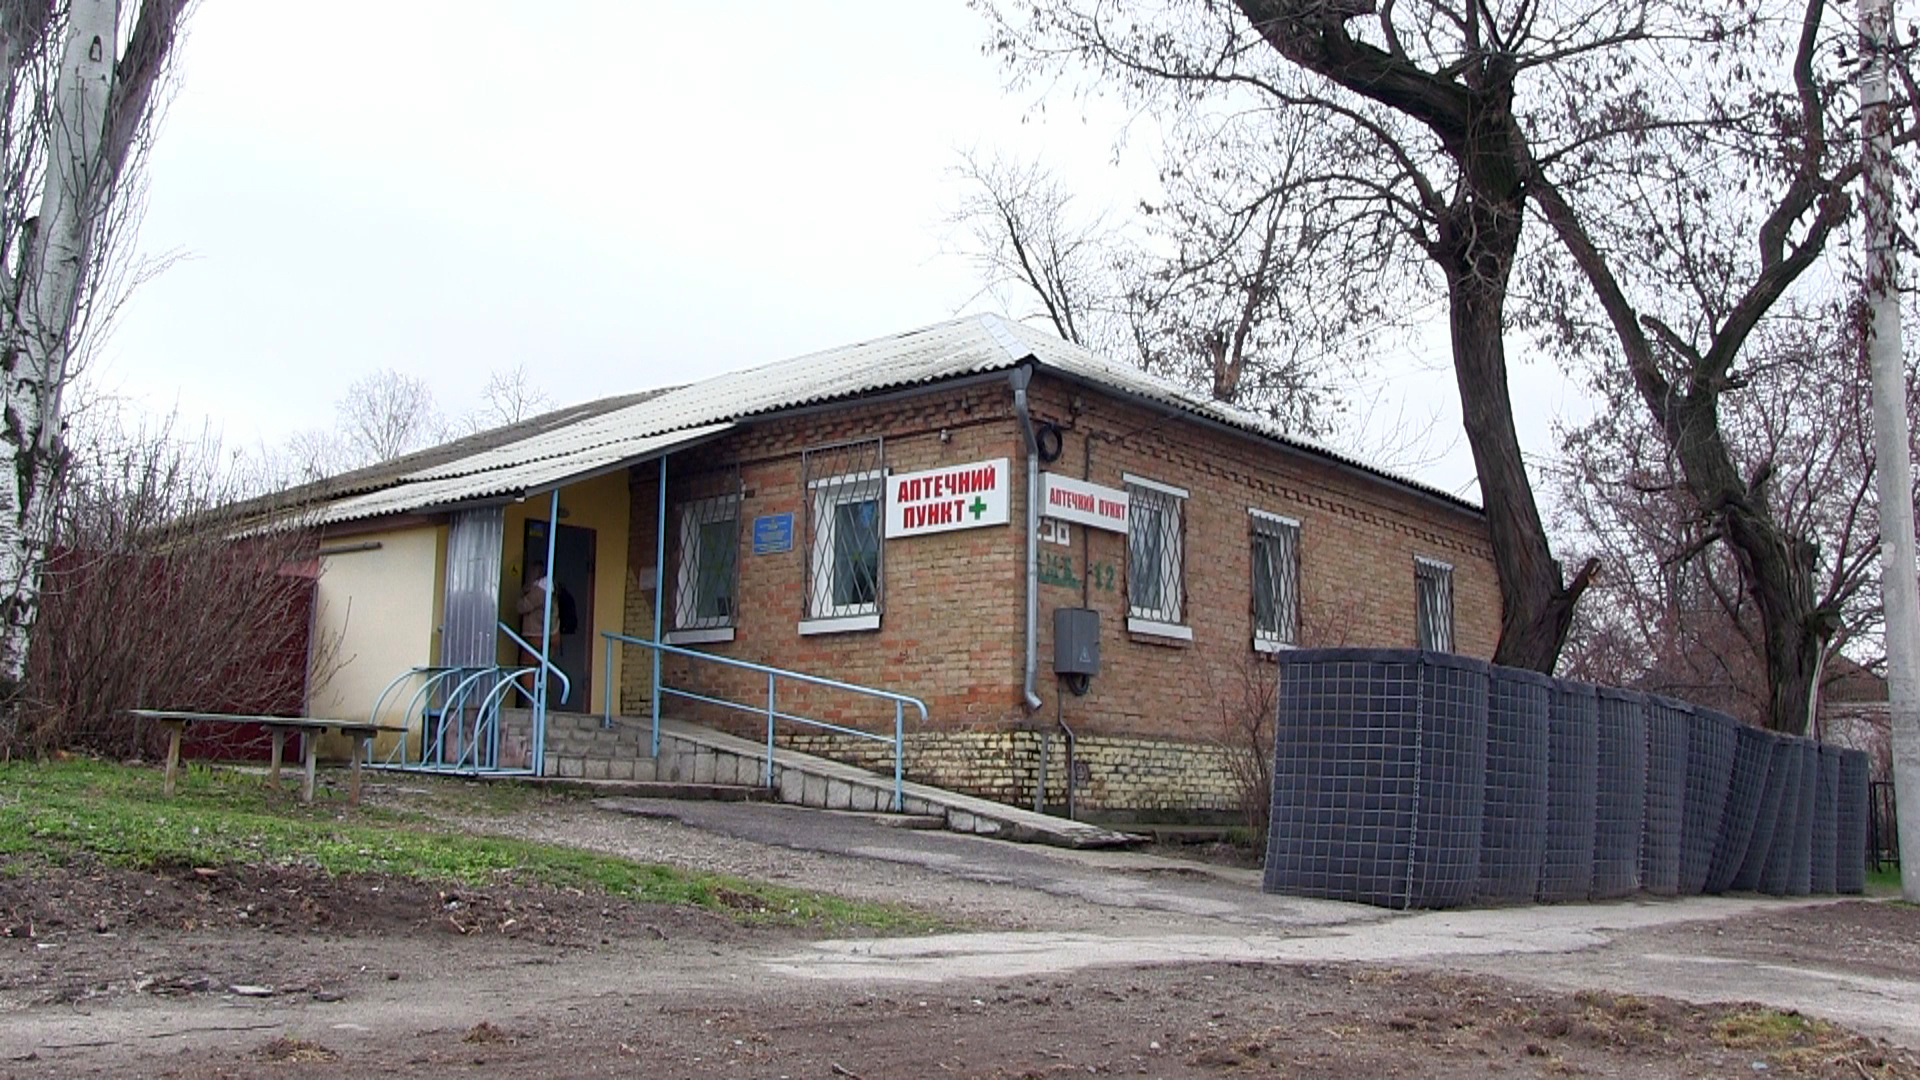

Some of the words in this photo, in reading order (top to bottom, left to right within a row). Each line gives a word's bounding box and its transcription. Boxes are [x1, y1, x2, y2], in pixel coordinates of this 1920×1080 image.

[897, 464, 996, 503] АПТЕЧНИЙ
[903, 499, 965, 529] ПУНКТ
[1049, 487, 1095, 514] АПТЕЧНИЙ
[1098, 498, 1126, 521] ПУНКТ
